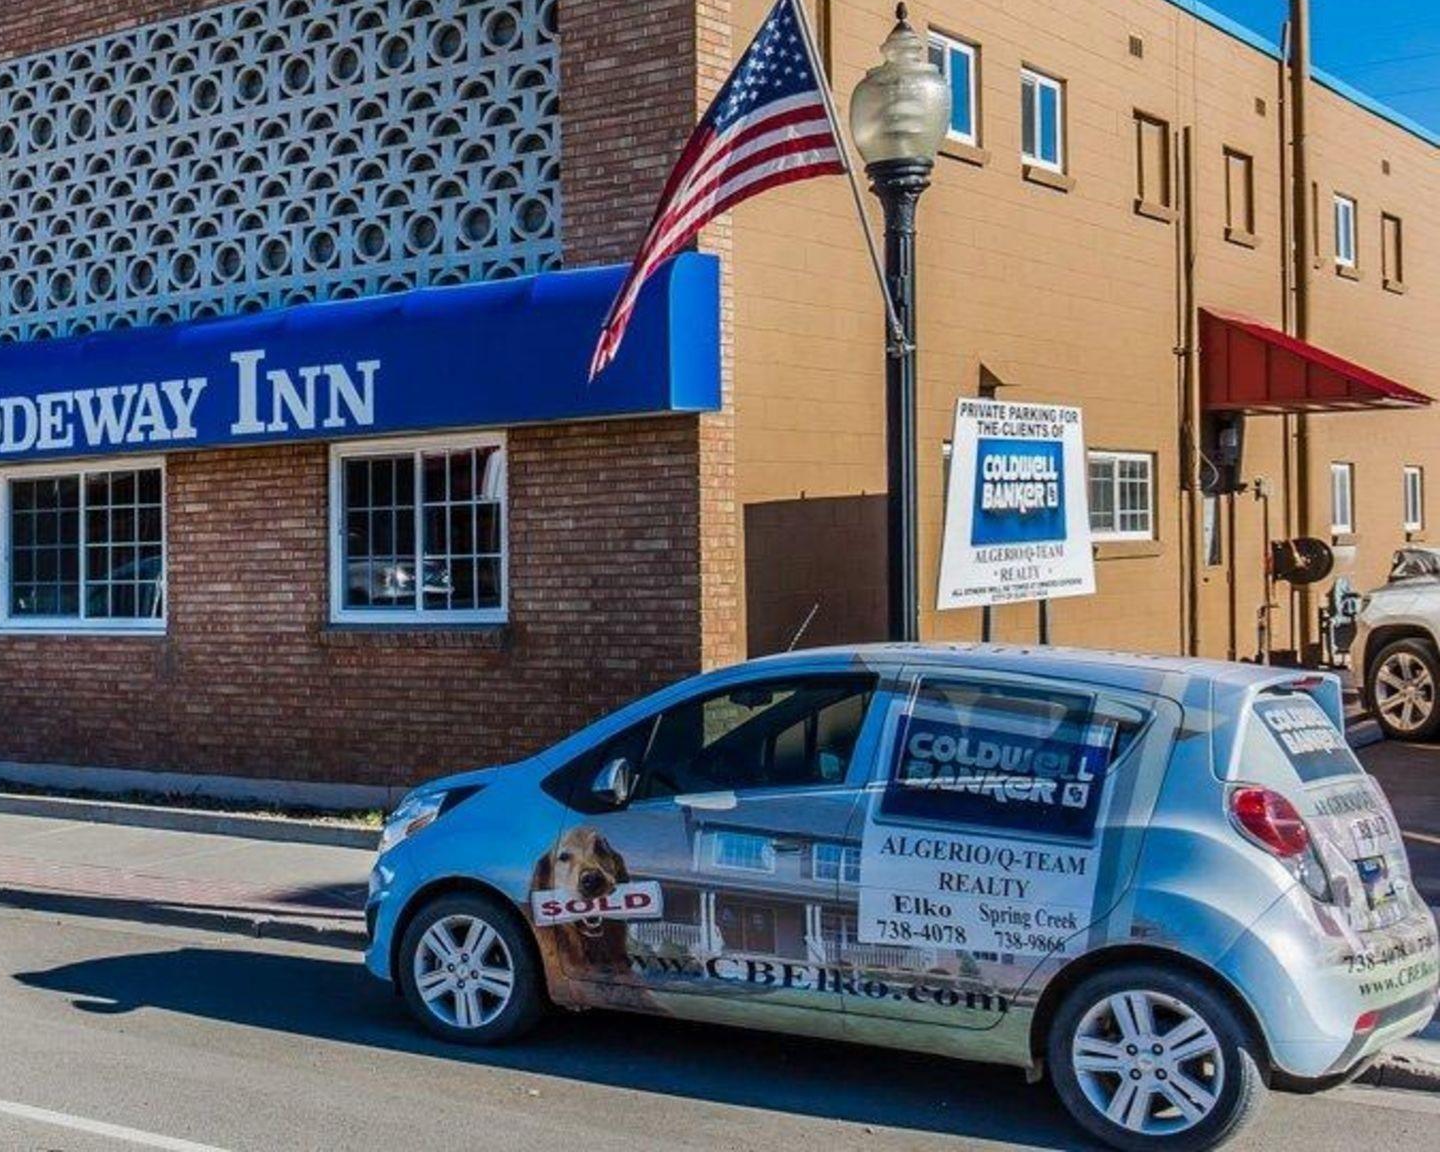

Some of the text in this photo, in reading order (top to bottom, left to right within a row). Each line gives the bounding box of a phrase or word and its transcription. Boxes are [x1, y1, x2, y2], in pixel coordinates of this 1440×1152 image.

[229, 349, 381, 436] INN
[960, 402, 1078, 423] PRIVATE PARKING FOR
[977, 420, 1065, 438] THE CLIENTS OF
[880, 835, 1088, 875] ALGERIO/Q-TEAM
[939, 871, 1031, 899] REALTY
[541, 892, 652, 917] SOLD
[893, 895, 1078, 931] Elko Spring Creek
[876, 919, 1067, 954] 738-4078 738-9866
[620, 955, 1010, 1013] ww.CBElko.com
